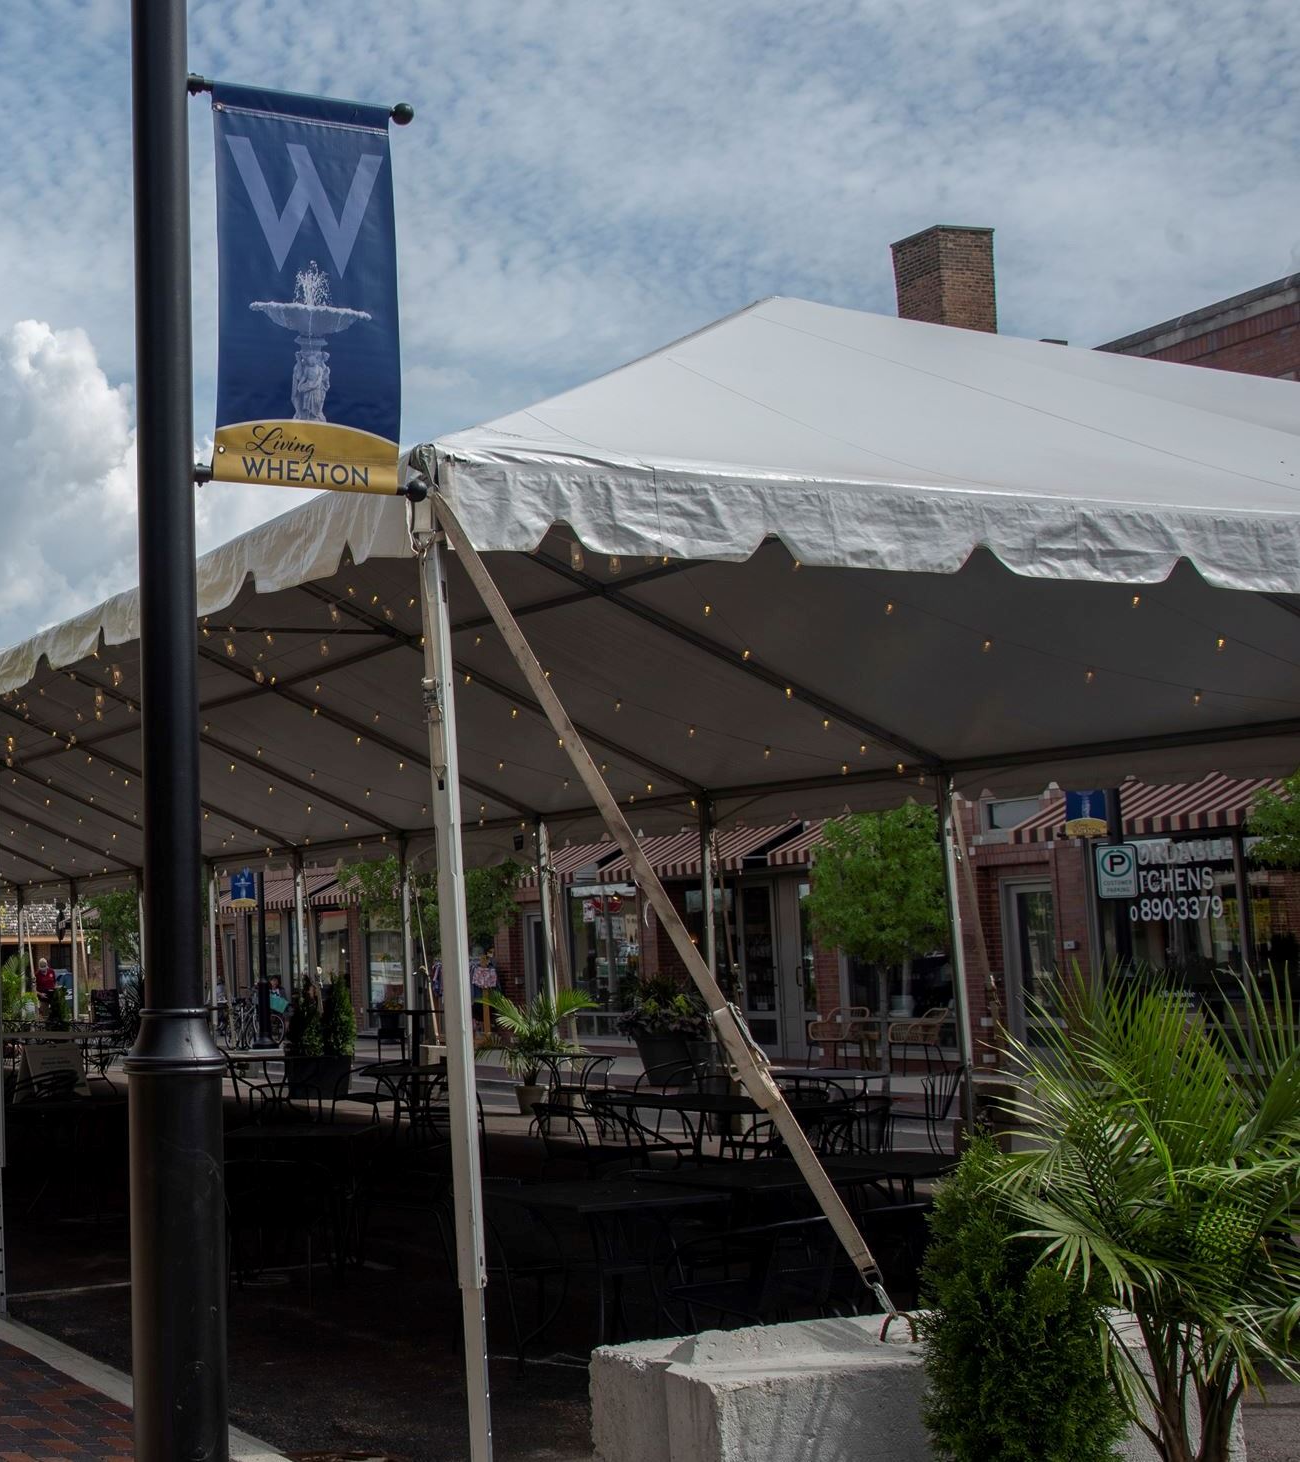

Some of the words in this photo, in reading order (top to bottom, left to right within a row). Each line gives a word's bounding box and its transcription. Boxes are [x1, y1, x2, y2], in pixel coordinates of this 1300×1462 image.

[226, 134, 383, 279] W
[245, 425, 316, 464] Living
[241, 456, 369, 487] WHEATON
[1110, 855, 1125, 872] P
[1138, 839, 1234, 866] ORDABLE
[1138, 866, 1214, 893] TCHENS
